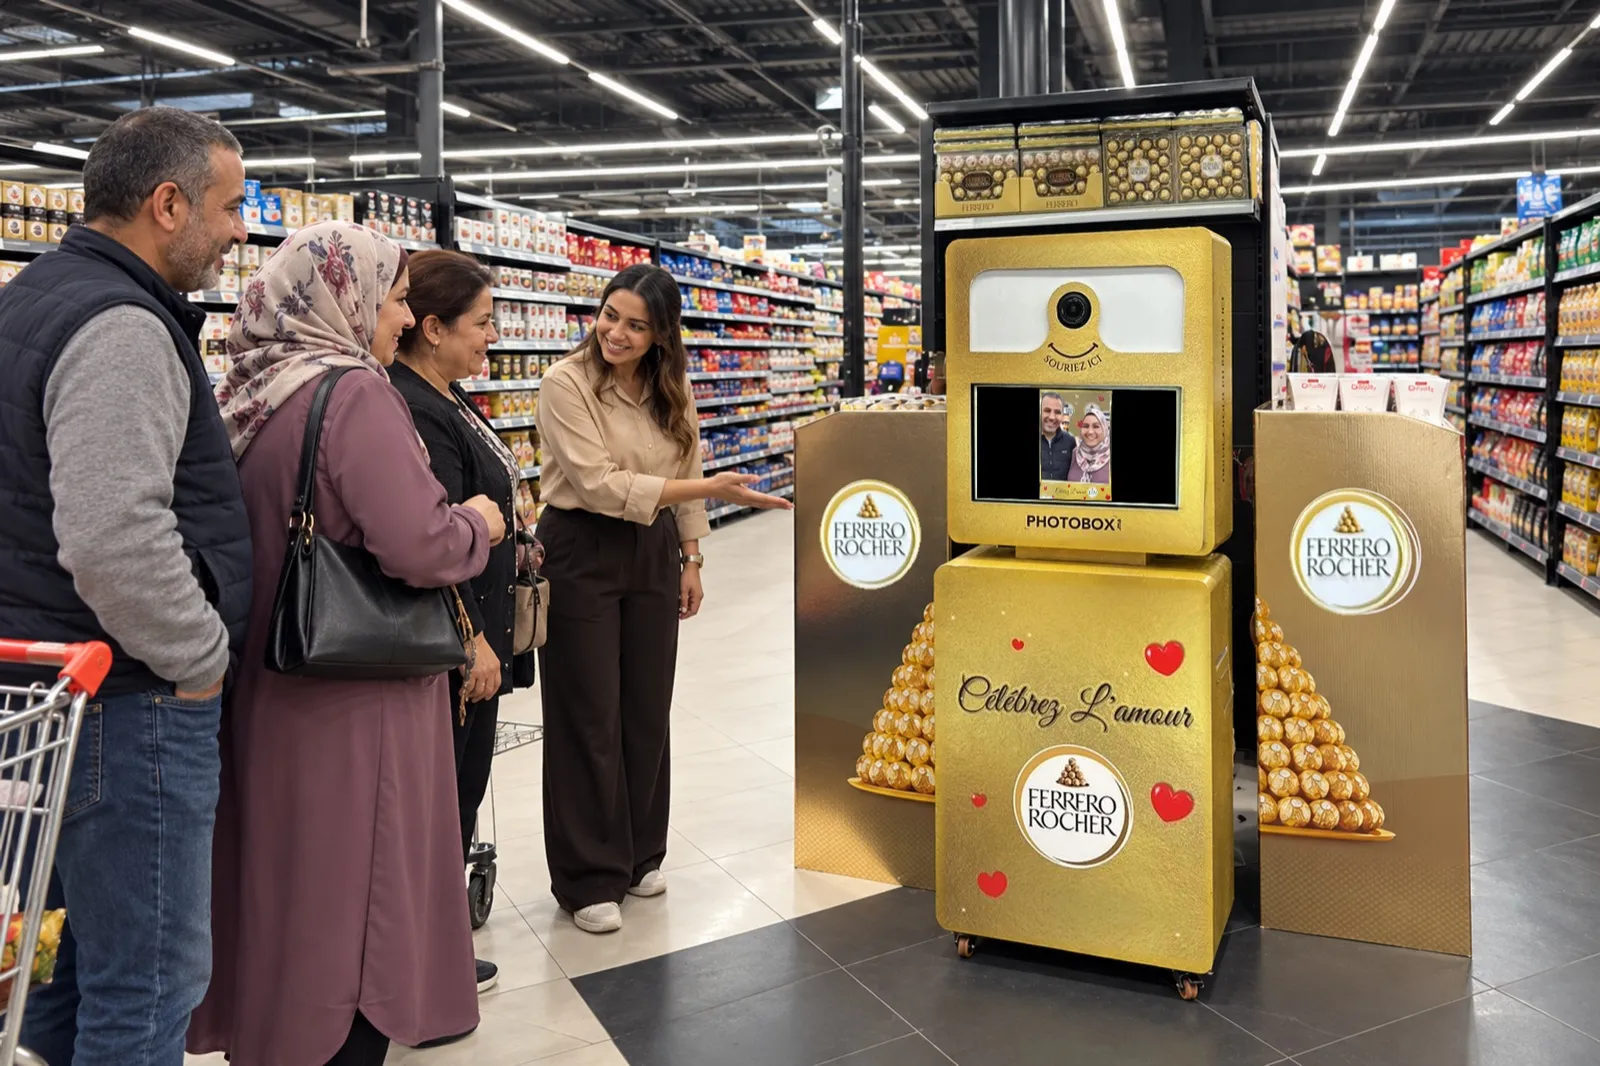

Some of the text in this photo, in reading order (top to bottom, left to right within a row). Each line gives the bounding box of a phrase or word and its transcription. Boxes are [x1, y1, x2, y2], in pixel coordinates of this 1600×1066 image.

[1043, 354, 1102, 372] SOURIEZ ICI
[834, 522, 906, 539] FERRERO
[1026, 515, 1115, 531] PHOTOBOX
[834, 539, 906, 556] ROCHER
[1306, 538, 1391, 557] FERRERO
[1307, 558, 1391, 577] ROCHER
[958, 673, 1194, 733] Célébrez L'amour
[1028, 788, 1117, 816] FERRERO
[1028, 808, 1118, 837] ROCHER
